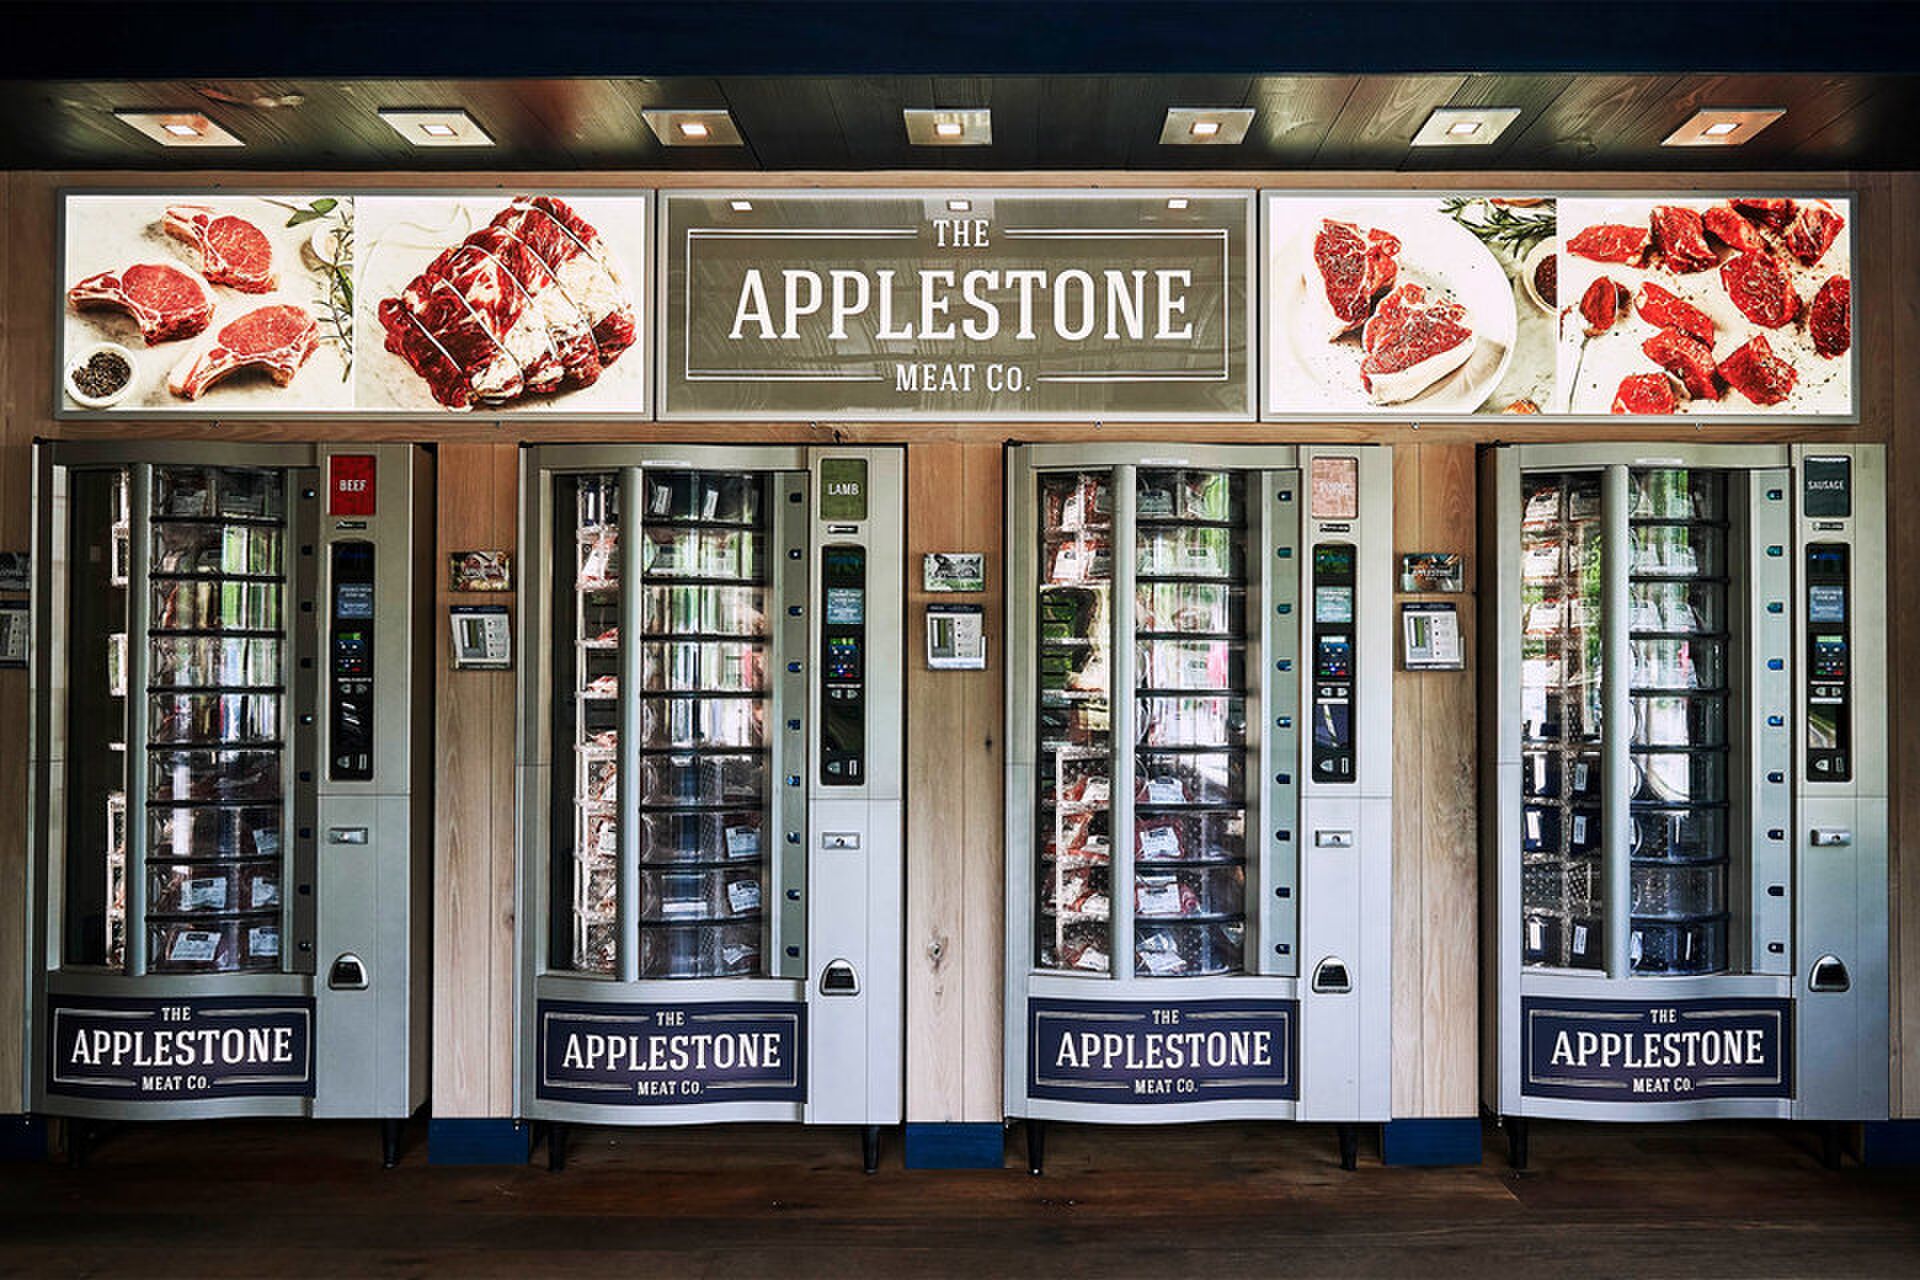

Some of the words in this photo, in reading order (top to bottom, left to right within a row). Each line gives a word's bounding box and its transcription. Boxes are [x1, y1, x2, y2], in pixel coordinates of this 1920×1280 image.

[933, 219, 990, 248] THE
[728, 268, 1194, 341] APPLESTONE
[895, 363, 975, 392] MEAT
[339, 479, 367, 493] BEEF
[827, 483, 860, 496] LAMB
[1807, 479, 1845, 491] SAUSAGE
[160, 1006, 192, 1022] THE
[655, 1011, 685, 1027] THE
[1152, 1009, 1179, 1024] THE
[1649, 1008, 1677, 1024] THE
[70, 1026, 293, 1068] APPLESTONE
[562, 1032, 782, 1072] APPLESTONE
[1056, 1030, 1272, 1070] APPLESTONE
[1551, 1029, 1765, 1070] APPLESTONE
[141, 1075, 182, 1092] MEAT
[637, 1080, 677, 1096] MEAT
[1134, 1079, 1173, 1095] MEAT
[1632, 1078, 1670, 1093] MEAT
